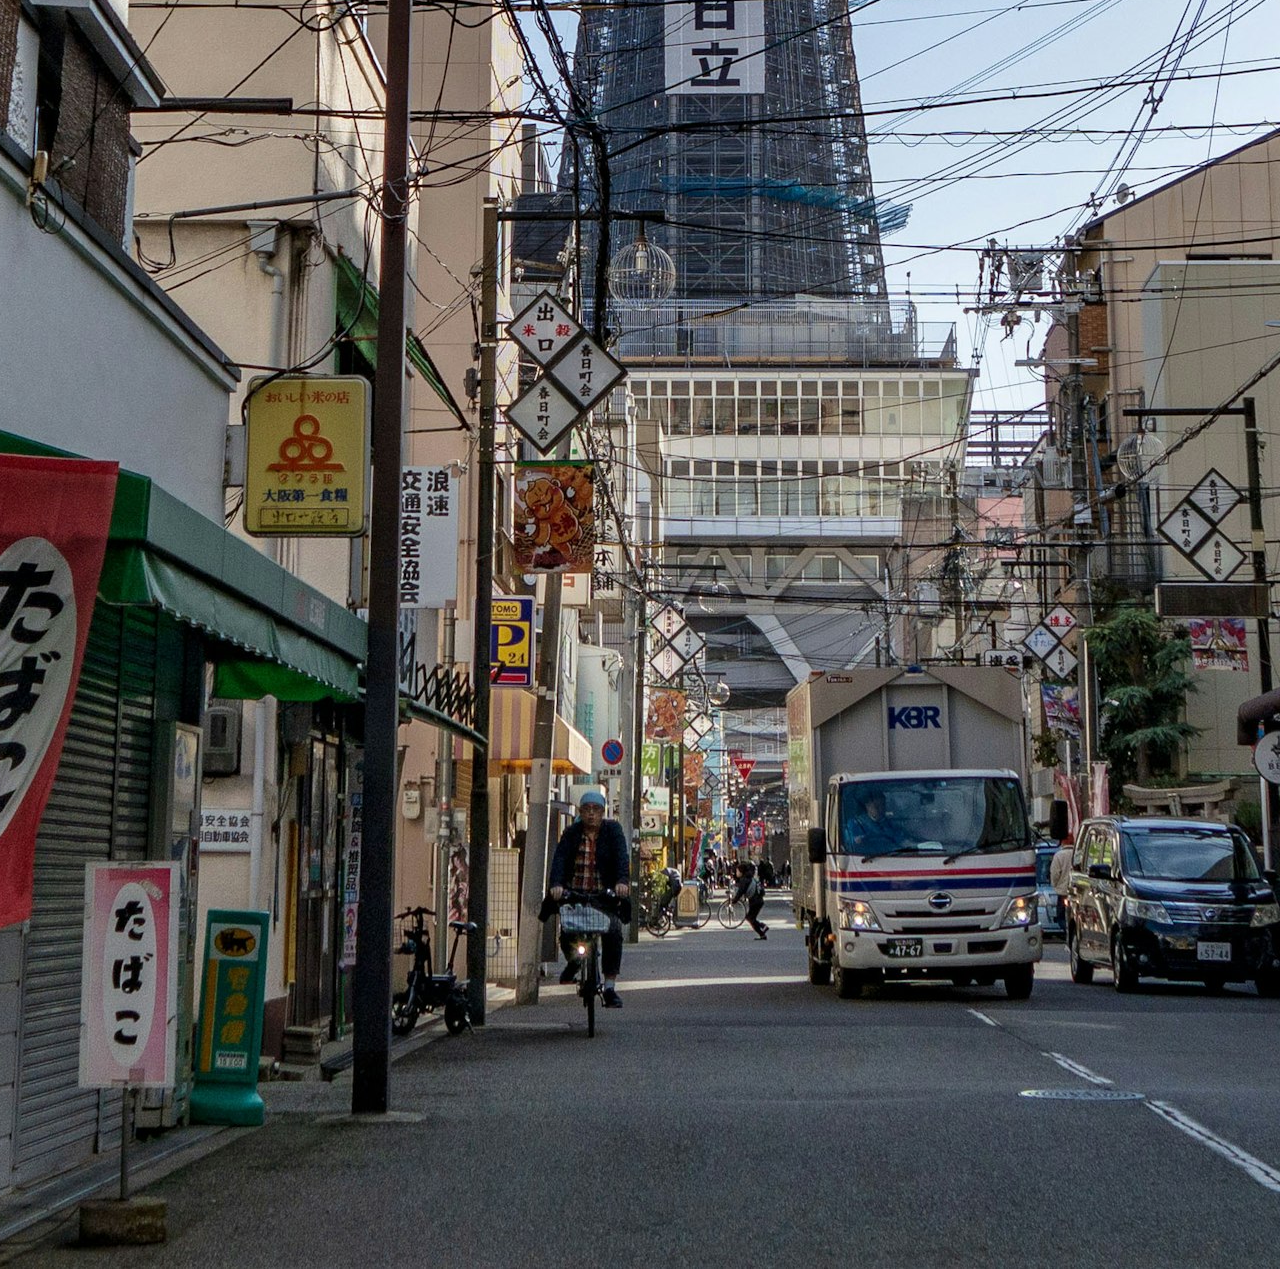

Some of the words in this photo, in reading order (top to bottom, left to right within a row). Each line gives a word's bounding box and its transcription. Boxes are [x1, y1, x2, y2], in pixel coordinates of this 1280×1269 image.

[579, 343, 593, 398] 春日町会
[265, 391, 350, 404] おいしい米の店
[537, 385, 551, 441] 春日町会
[263, 488, 348, 503] 大阪第一食糧
[426, 470, 449, 517] 浪速
[1209, 479, 1219, 514] 春日町会
[401, 470, 421, 604] 交通安全協会
[1181, 508, 1192, 549] 春日町会
[1214, 540, 1222, 575] 春日町会
[490, 624, 525, 663] P
[508, 652, 525, 664] 24
[888, 706, 941, 729] KBR
[895, 945, 922, 957] 47-67
[111, 898, 153, 1047] たばこ
